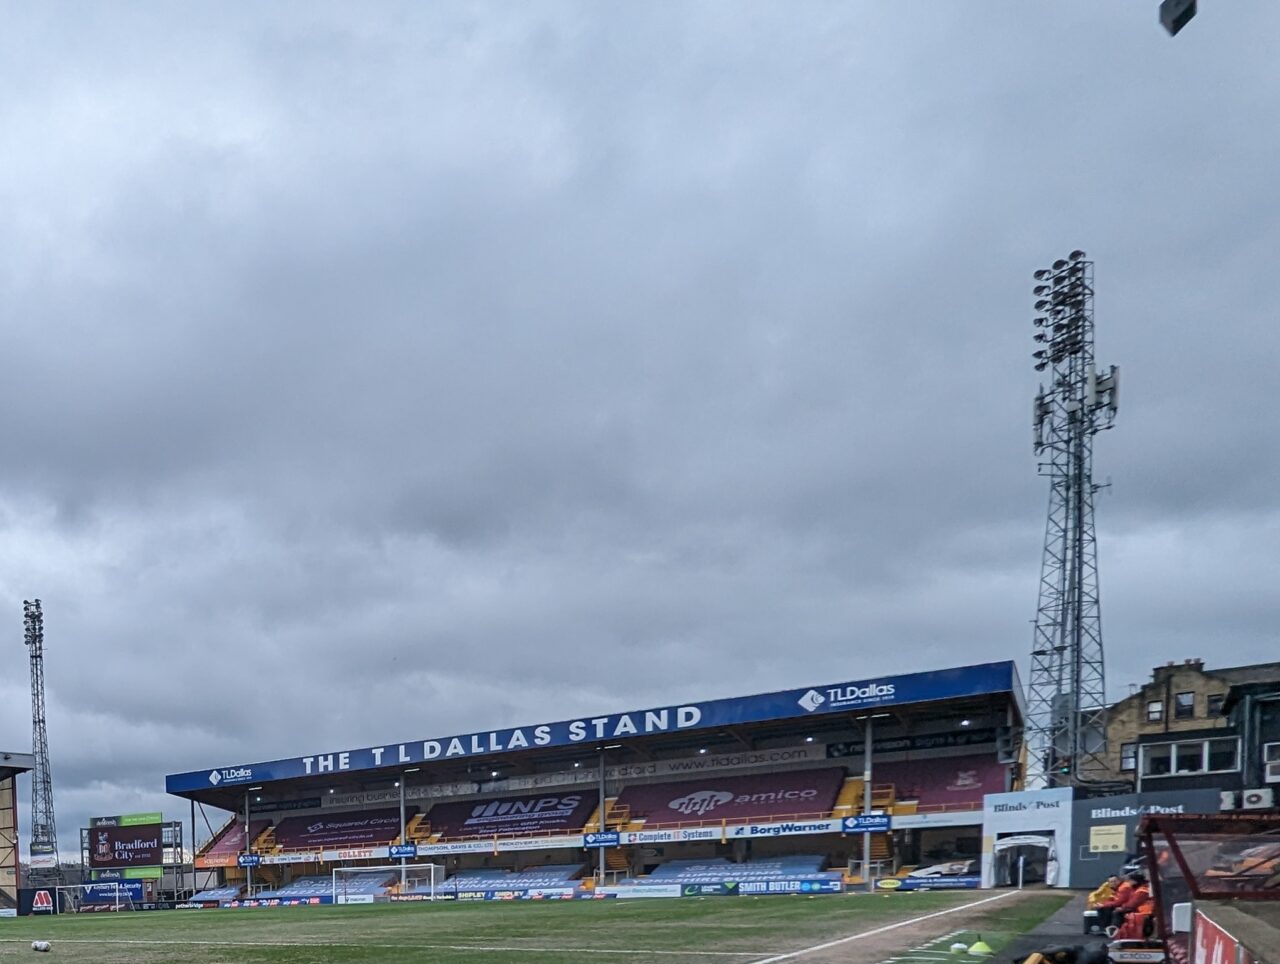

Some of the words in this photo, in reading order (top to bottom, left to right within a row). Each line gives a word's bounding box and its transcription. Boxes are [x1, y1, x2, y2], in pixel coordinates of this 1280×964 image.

[826, 683, 896, 702] TLDallas
[303, 752, 350, 774] THE
[371, 748, 384, 766] T
[399, 744, 411, 762] L
[424, 725, 551, 759] DALLAS
[569, 706, 701, 742] STAND
[221, 768, 252, 780] TLDallas
[734, 789, 818, 803] amico
[509, 795, 582, 814] NPS
[993, 802, 1028, 813] Blinds
[1035, 800, 1061, 809] Post
[1091, 806, 1137, 818] Blinds
[1150, 805, 1184, 814] Post
[326, 819, 368, 829] Squared
[370, 817, 400, 825] Circle
[638, 831, 671, 843] Complete
[682, 829, 713, 840] Systems
[750, 823, 831, 836] BorgWarner
[114, 838, 158, 850] Bradford
[114, 851, 134, 861] City
[337, 849, 374, 859] COLLETT
[632, 877, 720, 885] YORKSHIRE
[723, 874, 829, 882] BUSINESSES
[738, 882, 767, 892] SMITH
[768, 881, 801, 891] BUTLER
